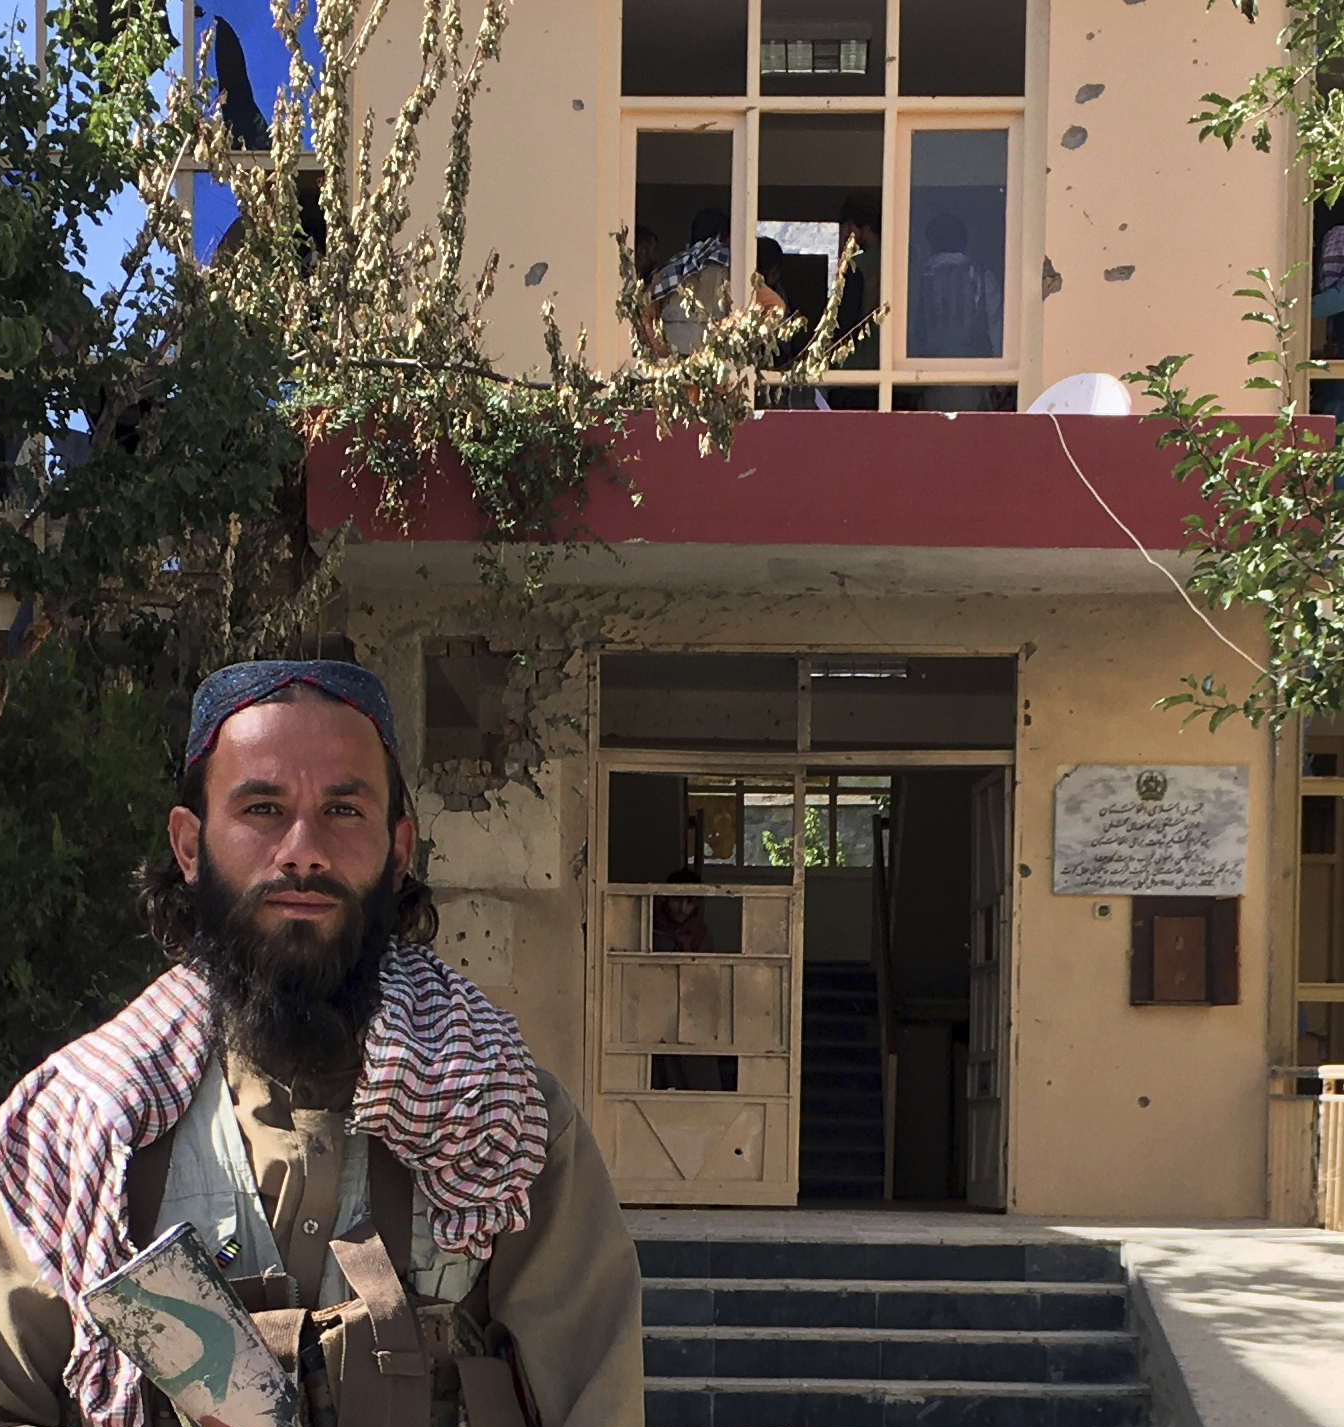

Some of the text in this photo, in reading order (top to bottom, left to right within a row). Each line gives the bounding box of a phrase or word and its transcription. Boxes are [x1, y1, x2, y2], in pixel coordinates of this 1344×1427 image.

[1098, 801, 1204, 817] جمهوری اسلامی افغانستان
